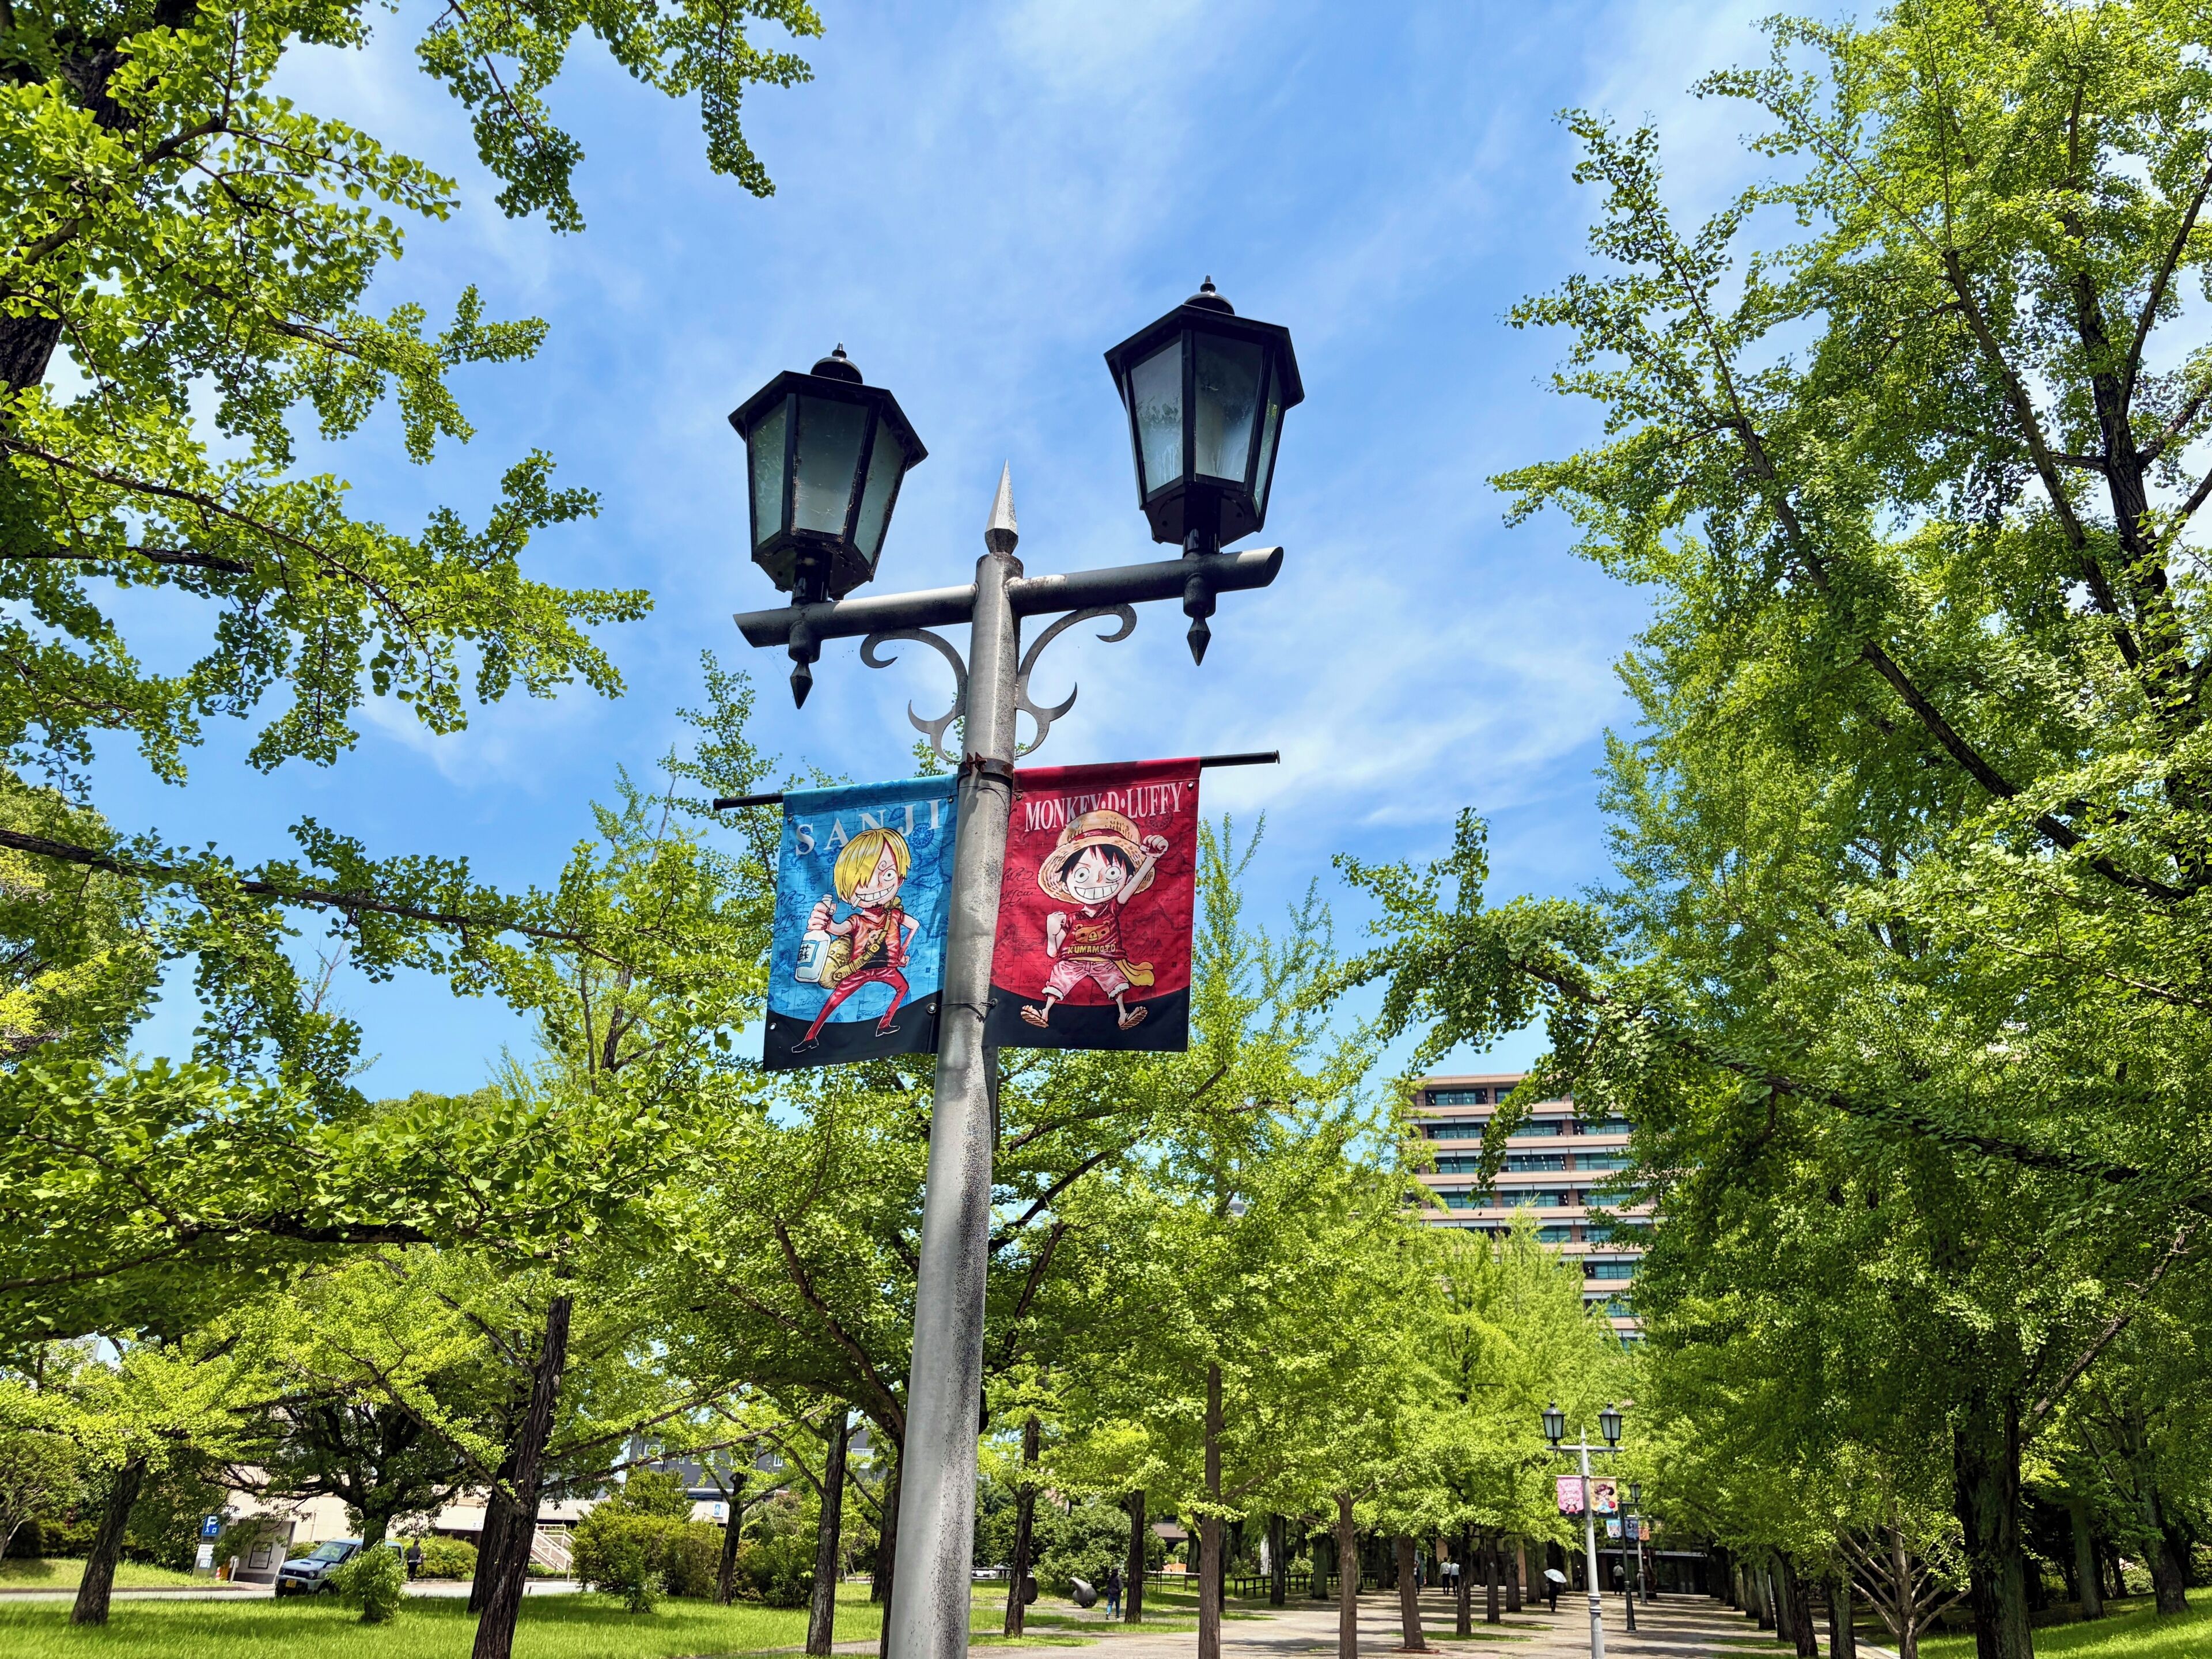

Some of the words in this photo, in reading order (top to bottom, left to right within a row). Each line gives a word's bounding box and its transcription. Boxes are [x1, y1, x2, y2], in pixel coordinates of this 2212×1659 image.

[796, 799, 942, 857] SANJI
[1067, 944, 1116, 955] KUMAMOTO
[206, 1516, 218, 1527] P
